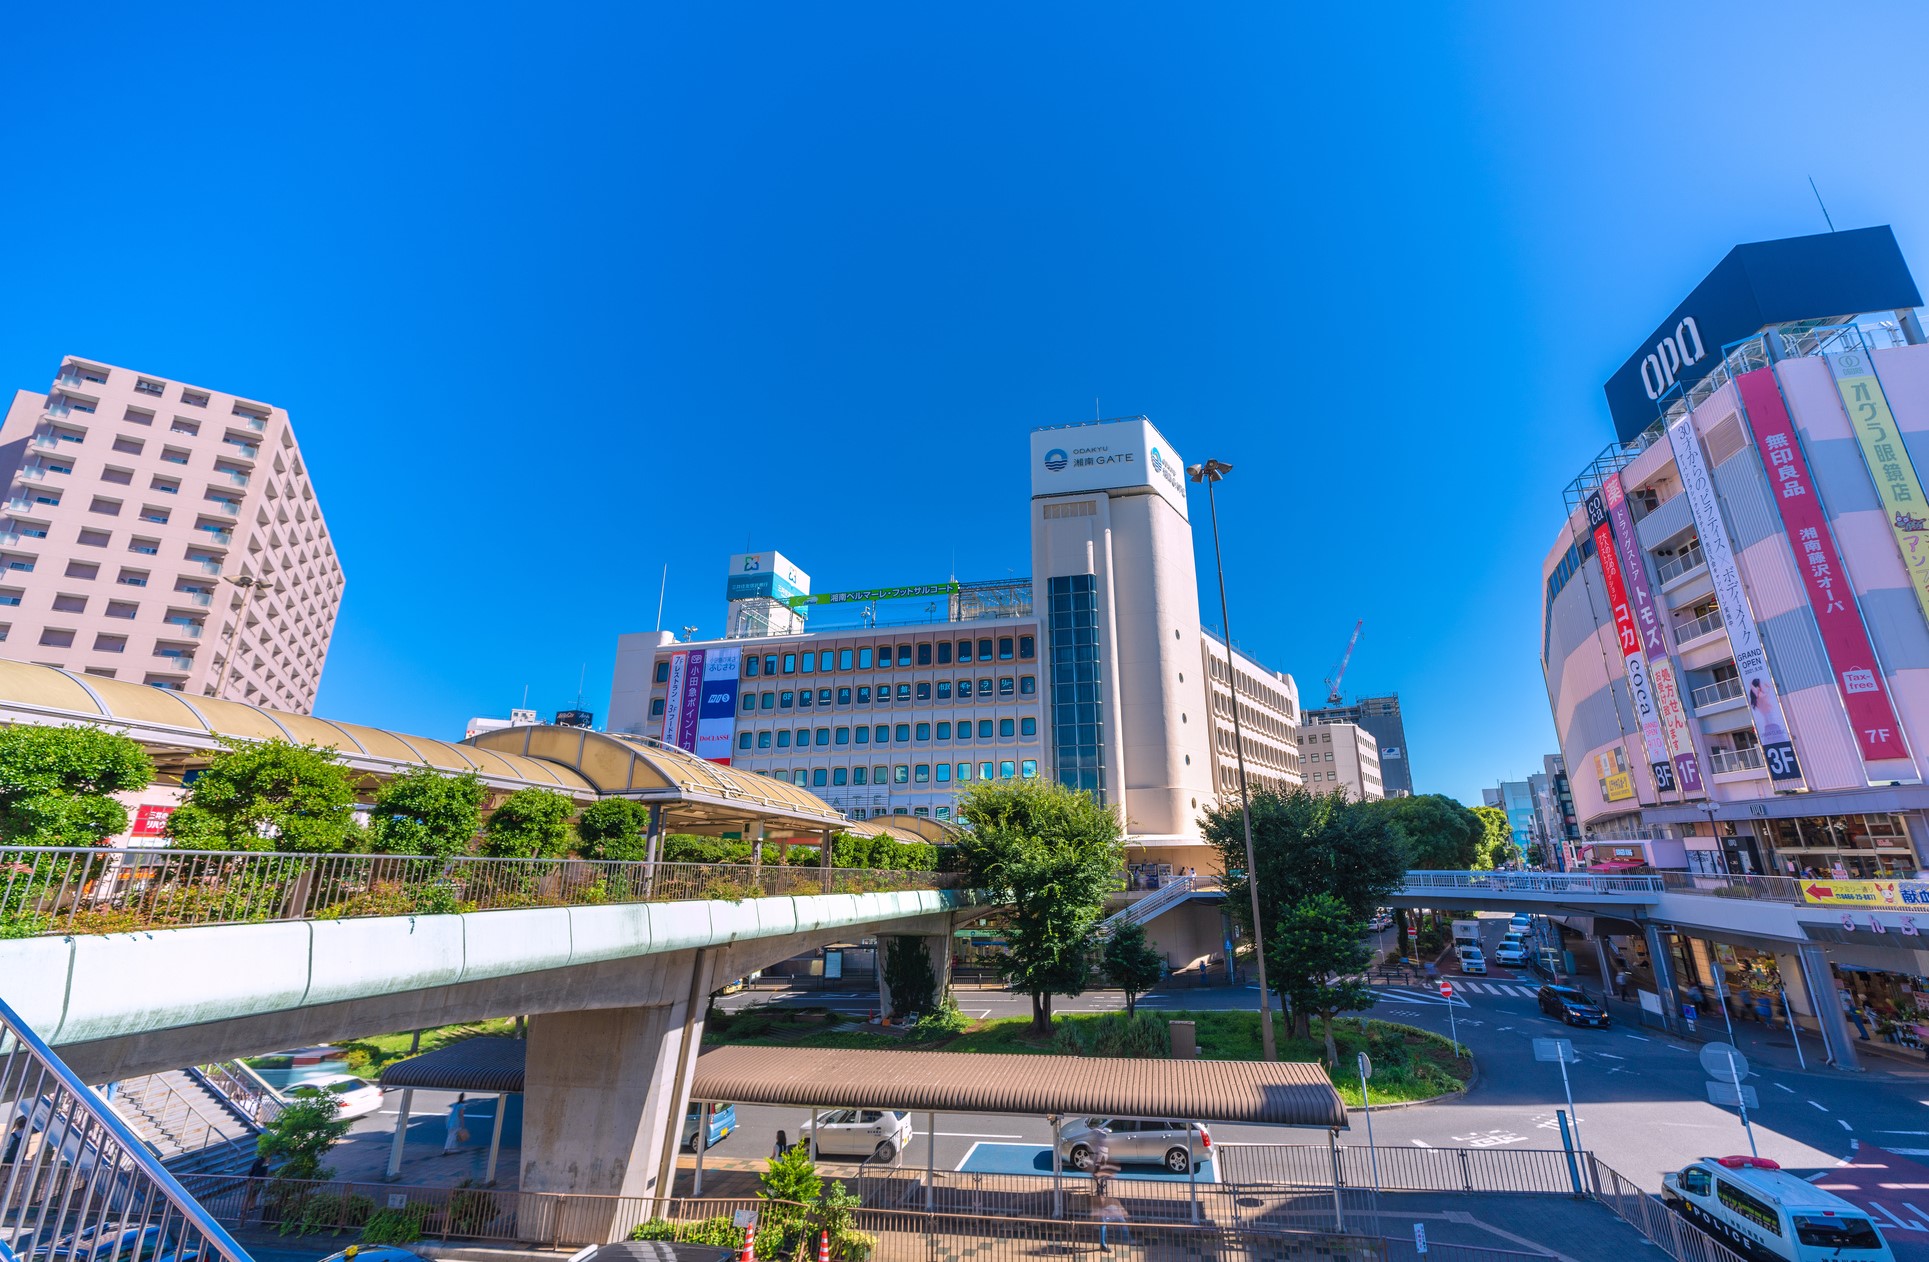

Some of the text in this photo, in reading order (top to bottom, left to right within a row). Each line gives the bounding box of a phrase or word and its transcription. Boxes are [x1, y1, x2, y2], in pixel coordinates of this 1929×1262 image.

[1073, 446, 1108, 455] ODAKYU
[1851, 382, 1912, 502] オグラ眼鏡店
[1765, 433, 1805, 498] 無印良品
[1606, 478, 1621, 506] 薬
[1617, 510, 1660, 649] ドラッグストア トモズ
[1799, 527, 1844, 614] 湘南藤沢オーパ
[830, 585, 954, 602] 湘南ベルマーレ・フットサルコート
[1615, 603, 1635, 649] コカ
[709, 663, 736, 672] ふじさわ
[1738, 648, 1762, 662] GRAND
[1742, 657, 1762, 669] OPEN
[1630, 660, 1650, 717] coca
[1846, 674, 1871, 682] Tax-
[1849, 682, 1874, 690] free
[1655, 671, 1679, 751] お受け致します
[1661, 668, 1684, 729] 処方せん
[1865, 729, 1890, 743] 7F
[1678, 760, 1696, 784] 1F
[1767, 747, 1794, 774] 3F
[1655, 765, 1672, 788] 8F
[1693, 1206, 1751, 1249] POLICE
